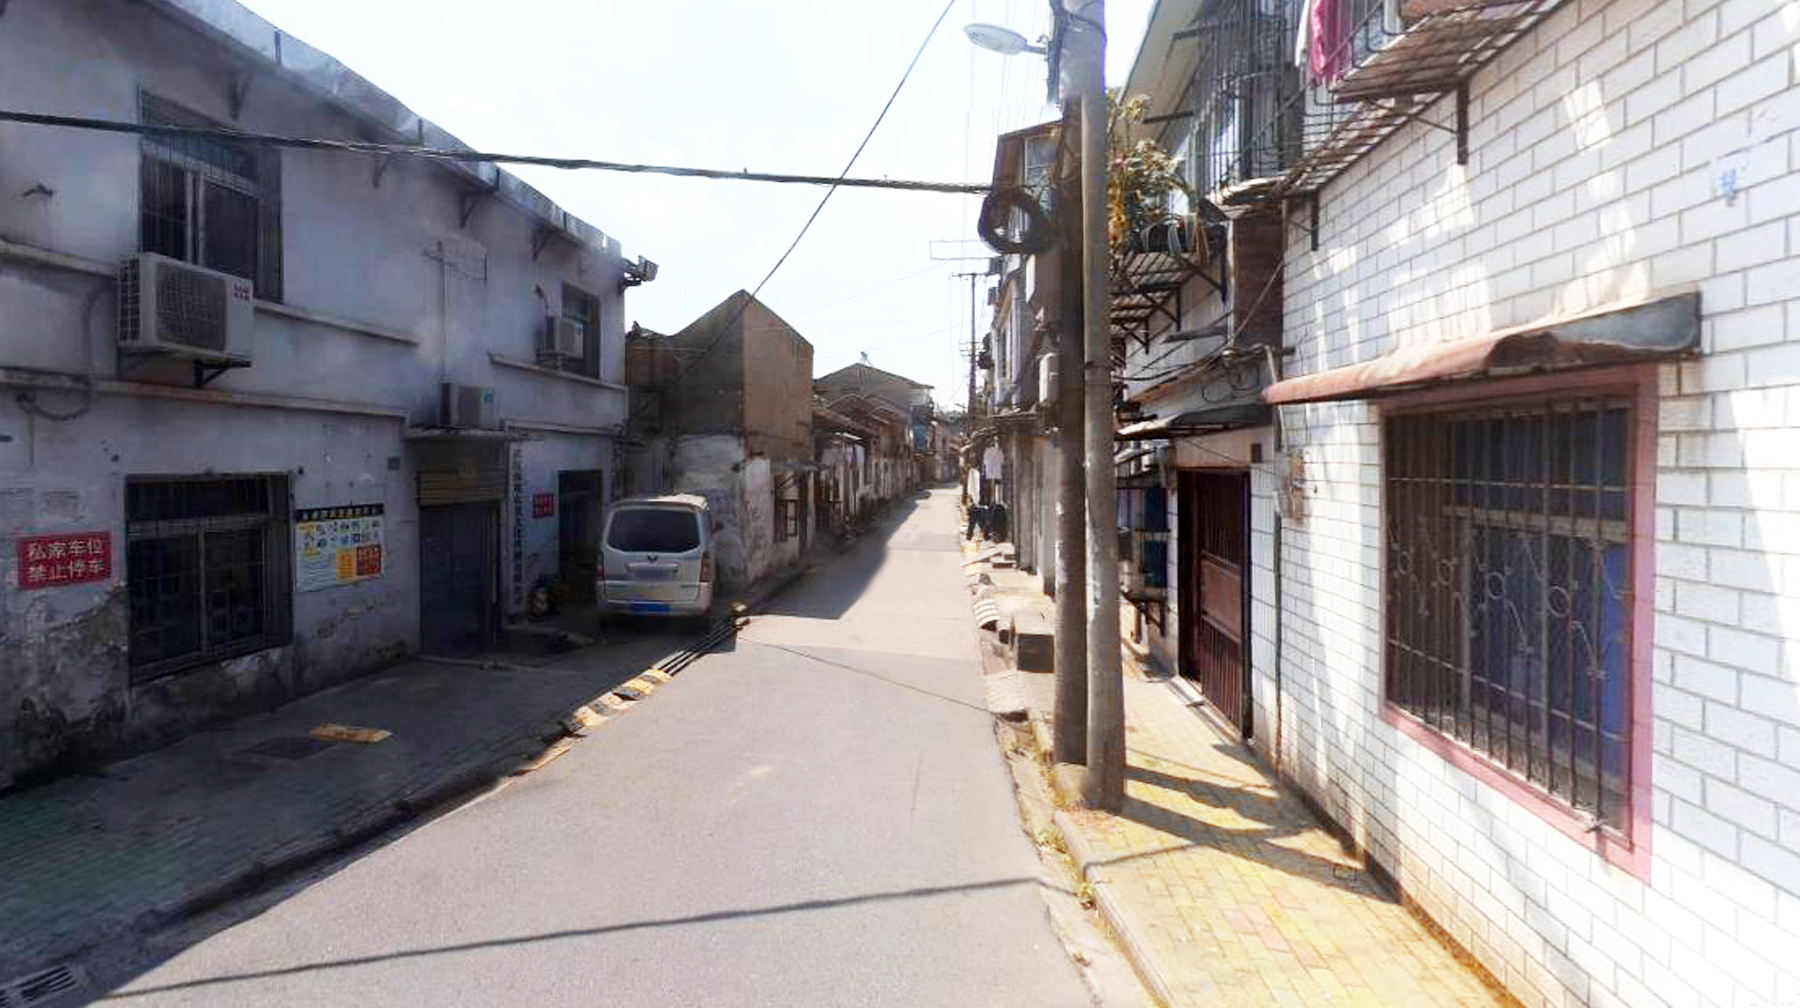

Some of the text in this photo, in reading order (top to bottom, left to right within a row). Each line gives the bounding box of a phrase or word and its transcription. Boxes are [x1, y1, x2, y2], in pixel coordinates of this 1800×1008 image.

[28, 539, 104, 559] 私家车位
[27, 560, 105, 581] 禁止停车
